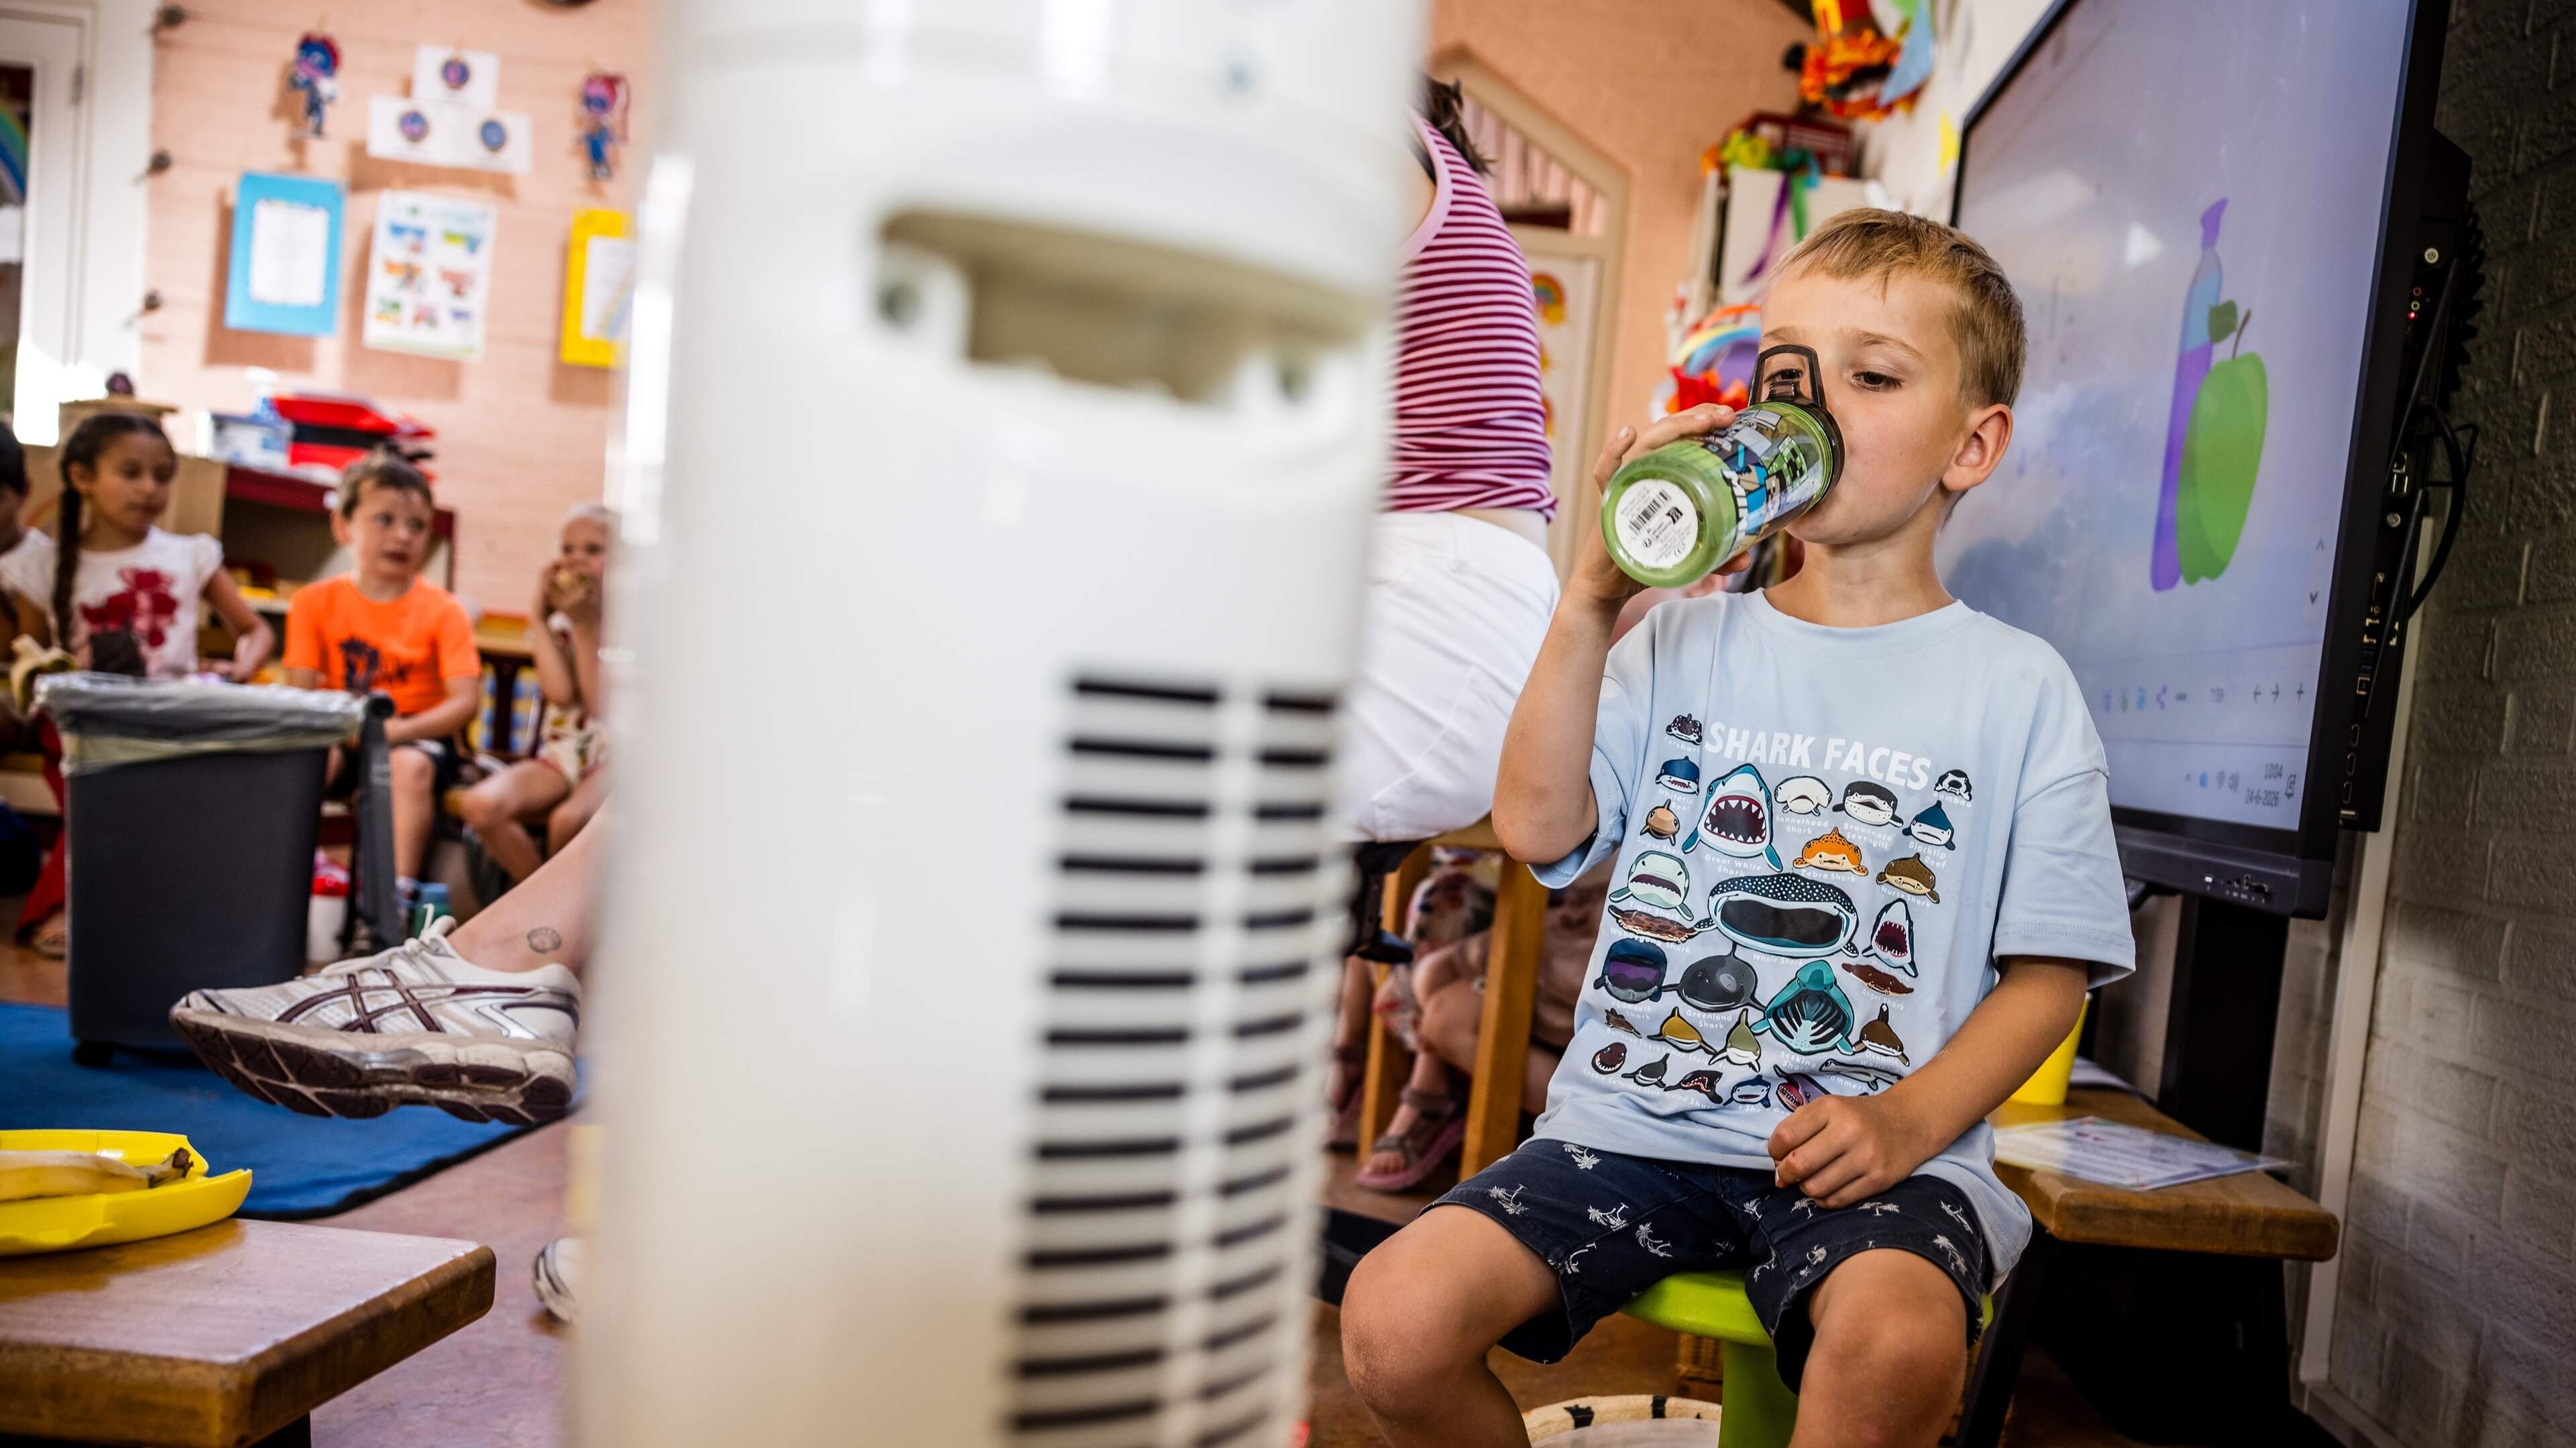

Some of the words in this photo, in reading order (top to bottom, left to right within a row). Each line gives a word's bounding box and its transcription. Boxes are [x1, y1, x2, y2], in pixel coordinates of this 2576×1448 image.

[1705, 722, 1815, 769] SHARK
[1823, 738, 1932, 791] FACES
[1658, 787, 1694, 804] Whitetip
[1933, 791, 1972, 807] Bamboo
[1786, 826, 1813, 835] Shark
[1847, 832, 1890, 852] Sevengill
[1909, 841, 1947, 860] Blacktip
[1705, 853, 1731, 866] Great
[1735, 858, 1762, 871] White
[1925, 854, 1947, 869] Reef
[1717, 865, 1745, 877] Shark
[1801, 869, 1829, 880] Zebra
[1831, 873, 1856, 883] Shark
[1881, 886, 1904, 901] Nurse
[1907, 894, 1931, 909] Shark
[1630, 900, 1652, 914] Tiger
[1655, 907, 1680, 921] Shark
[1665, 942, 1691, 954] Shark
[1753, 953, 1777, 963] Whale
[1780, 956, 1805, 966] Shark
[1625, 1011, 1651, 1020] Shark
[1686, 1009, 1732, 1021] Greenland
[1699, 1020, 1725, 1029] Shark
[1607, 1029, 1638, 1046] Bullhead
[1639, 1040, 1661, 1052] Shark
